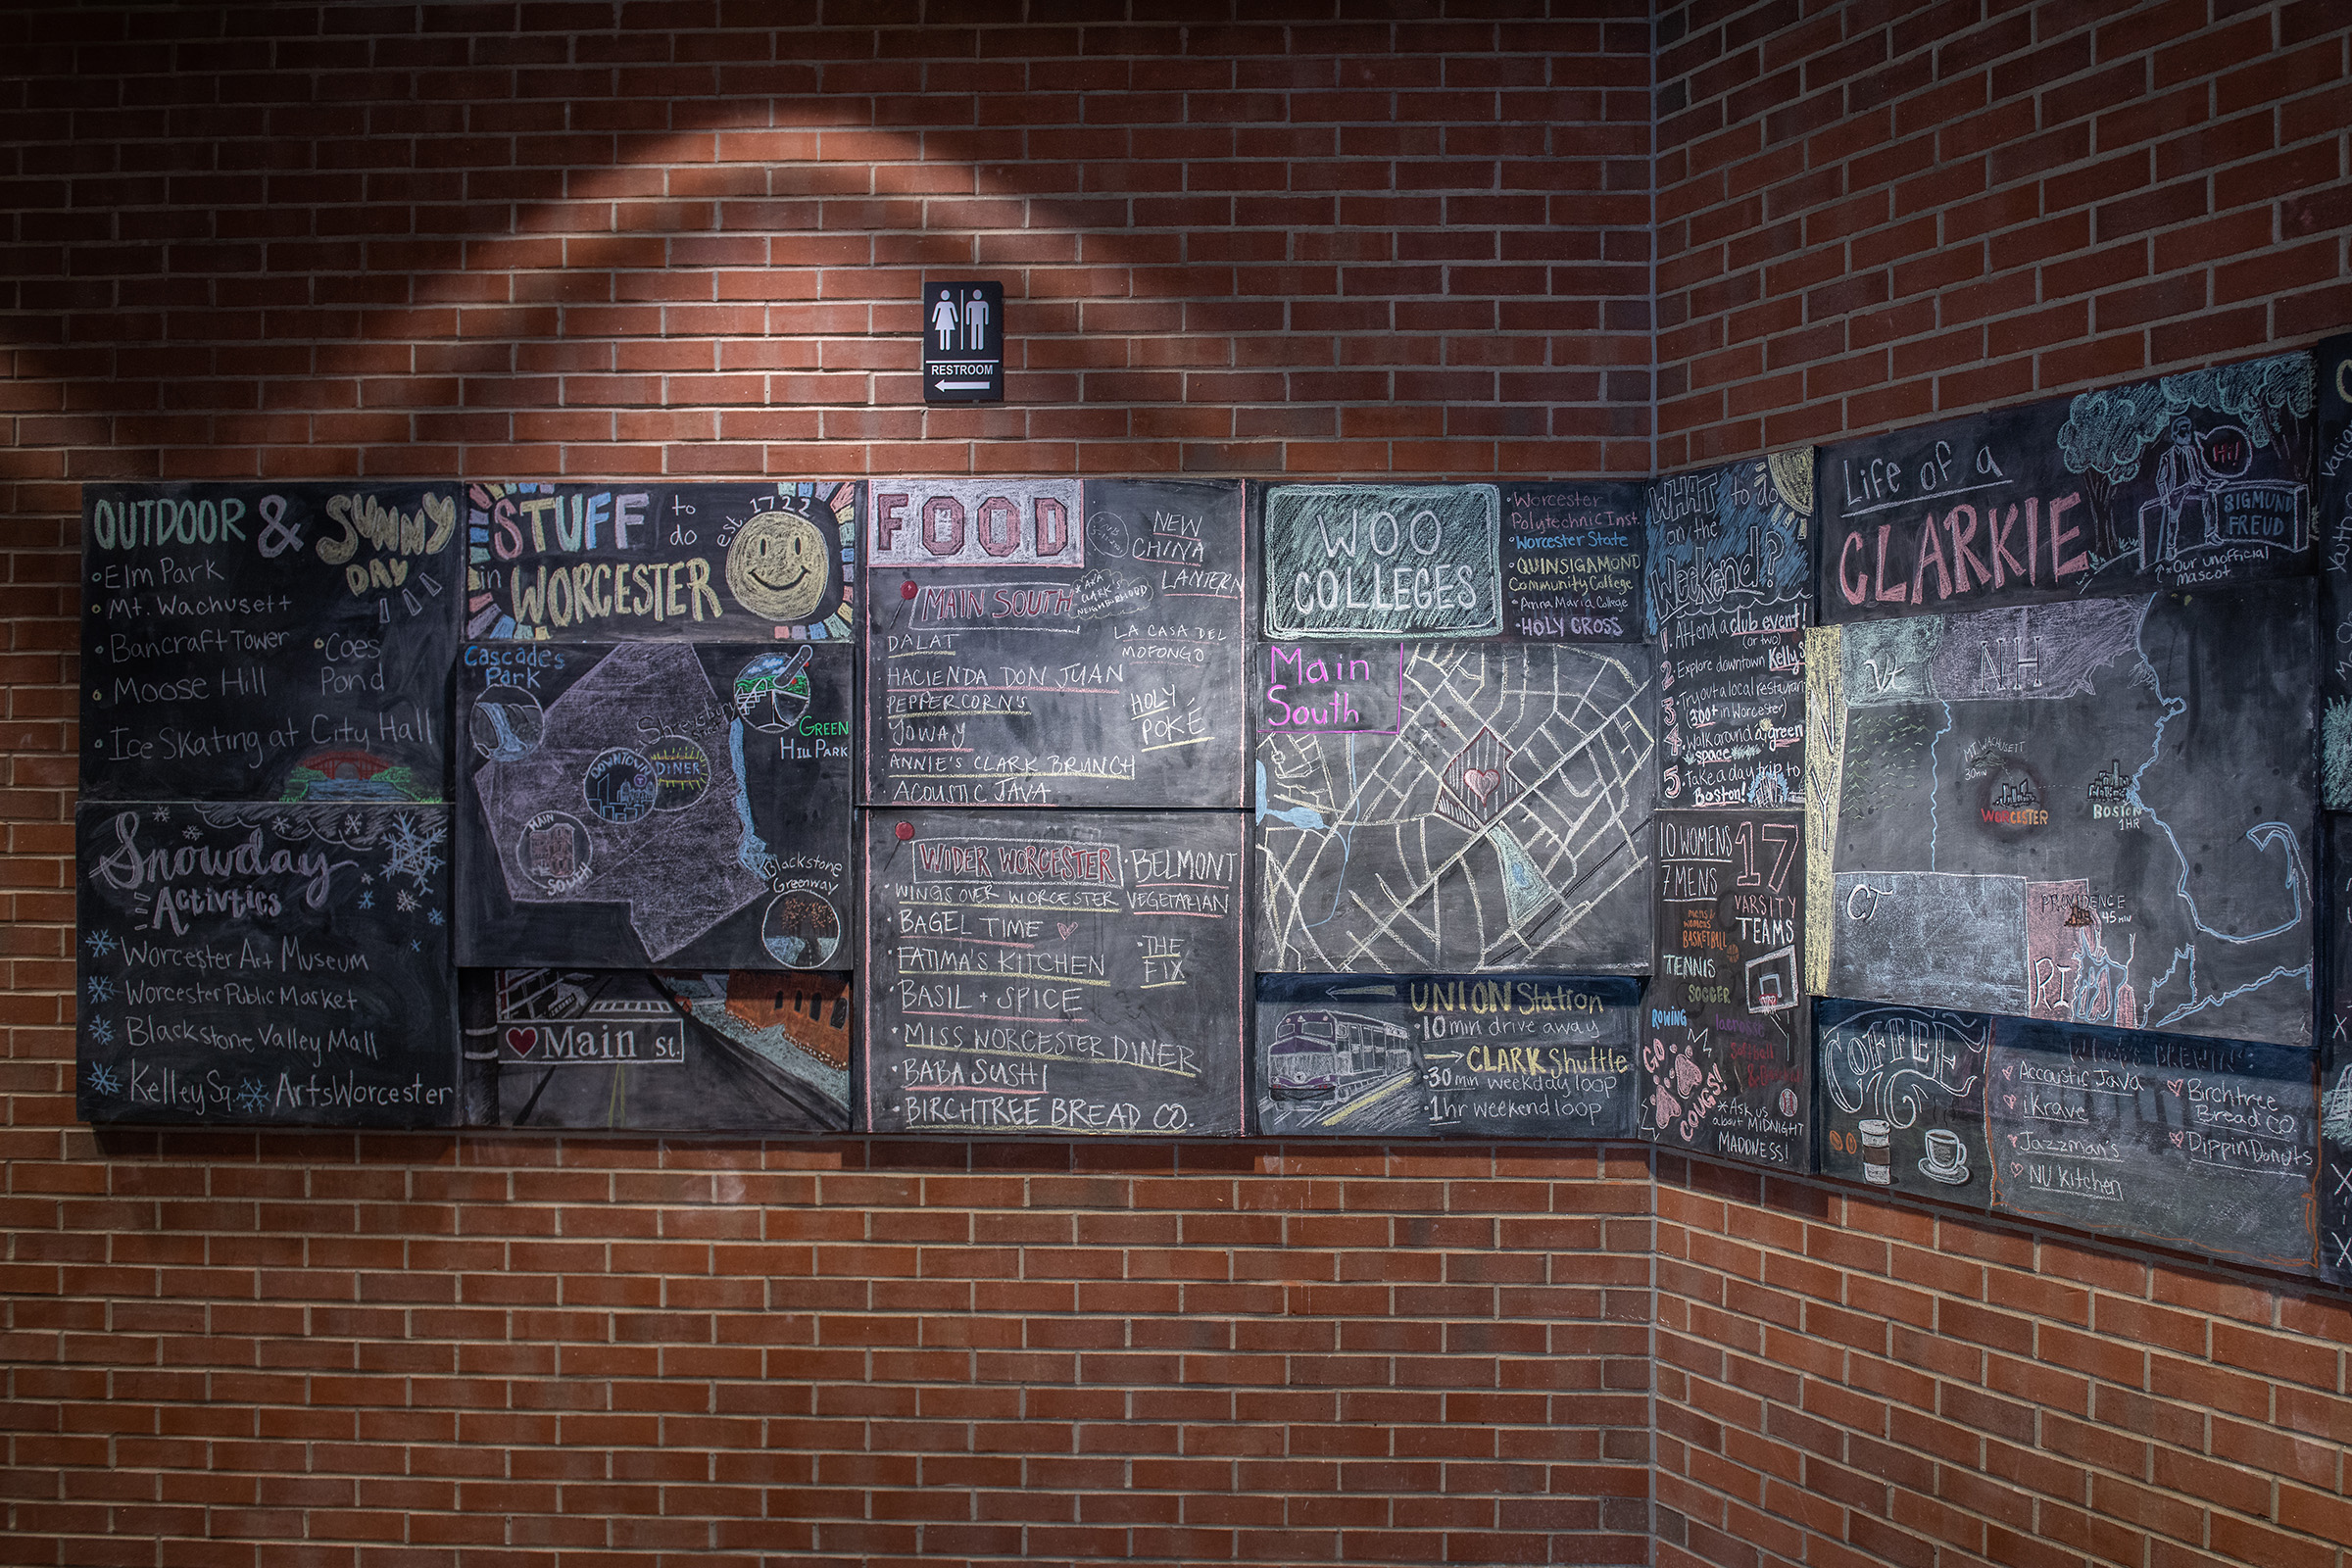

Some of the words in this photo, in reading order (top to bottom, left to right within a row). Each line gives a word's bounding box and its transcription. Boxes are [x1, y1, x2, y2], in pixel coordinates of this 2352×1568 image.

[931, 365, 993, 375] RESTROOM
[1843, 459, 1900, 507] Life
[1921, 441, 1951, 491] of
[672, 495, 696, 515] to
[750, 496, 811, 516] 1722
[1514, 492, 1602, 508] Worcester
[1648, 473, 1717, 524] WHAT
[1732, 476, 1749, 505] to
[1757, 479, 1778, 506] do
[2224, 491, 2294, 513] SIGMUND
[95, 498, 245, 550] OUTDOOR
[258, 495, 304, 557] &
[316, 492, 456, 564] SUNNY
[495, 493, 650, 561] STUFF
[670, 525, 697, 546] do
[878, 494, 1068, 558] FOOD
[1152, 511, 1202, 537] NEW
[1316, 510, 1443, 558] WOO
[1694, 517, 1717, 539] the
[2230, 514, 2284, 536] FREUD
[1132, 537, 1203, 563] CHINA
[1516, 535, 1585, 549] Worcester
[1588, 531, 1628, 548] State
[1839, 492, 2089, 605] CLARKIE
[1517, 554, 1641, 575] QUINSIGAMOND
[2203, 546, 2269, 568] unofficial
[106, 565, 153, 588] Elm
[161, 558, 223, 583] Park
[346, 559, 408, 597] DAY
[1161, 569, 1243, 597] LANTERN
[1590, 574, 1633, 595] College
[2177, 568, 2230, 586] mascot
[480, 565, 501, 588] in
[512, 558, 723, 627] WORCESTER
[1294, 564, 1477, 614] COLLEGES
[158, 595, 291, 615] Wachusett
[922, 588, 984, 621] MAIN
[992, 588, 1074, 618] SOUTH
[1520, 597, 1553, 611] Anna
[1148, 625, 1188, 638] CASA
[1522, 615, 1563, 636] HOLY
[1571, 616, 1624, 636] CROSS
[1676, 616, 1718, 649] Attend
[1730, 608, 1758, 633] club
[231, 629, 289, 651] Tower
[325, 633, 380, 662] Coes
[889, 634, 959, 652] DALAT
[466, 646, 564, 669] Cascades
[1122, 647, 1204, 662] MOFONGO
[1270, 646, 1370, 684] Main
[1677, 660, 1712, 678] Explore
[1716, 656, 1765, 674] downtown
[1769, 647, 1800, 674] Kelly
[1981, 636, 2042, 693] NH
[116, 677, 210, 704] Moose
[222, 667, 267, 696] Hill
[322, 663, 384, 695] Pond
[486, 668, 540, 688] Park
[888, 668, 989, 686] HACIENDA
[1002, 666, 1047, 686] DON
[1060, 663, 1123, 691] JUAN
[1130, 685, 1178, 715] HOLY
[1268, 685, 1359, 726] South
[109, 727, 153, 760] Ice
[270, 718, 298, 746] at
[312, 714, 368, 752] City
[380, 709, 432, 744] Hall
[799, 715, 849, 736] GREEN
[1768, 723, 1803, 752] green
[781, 738, 811, 760] HILL
[815, 738, 848, 759] PARK
[1978, 736, 2026, 753] WACHUSETT
[590, 753, 653, 779] DOWNTOWN
[656, 761, 700, 775] DINER
[974, 756, 1038, 772] CLARK
[1048, 755, 1135, 780] BRUNCH
[893, 781, 987, 803] ACOUSTIC
[993, 776, 1051, 803] JAVA
[528, 813, 555, 832] MAIN
[1981, 808, 2048, 824] WORCESTER
[2093, 804, 2141, 819] BOSTON
[100, 811, 359, 908] Snowday
[762, 855, 843, 879] Blackstone
[920, 844, 989, 876] WIDER
[998, 846, 1115, 882] WORCESTER
[1130, 848, 1238, 882] BELMONT
[1661, 822, 1675, 857] 10
[1681, 825, 1733, 858] WOMENS
[1735, 821, 1798, 893] 17
[546, 865, 593, 896] SOUTH
[772, 877, 838, 895] Greenway
[1675, 865, 1717, 897] MENS
[895, 886, 953, 904] WINGS
[959, 884, 999, 904] OVER
[1008, 891, 1119, 906] WORCESTER
[1127, 890, 1229, 913] VEGETARIAN
[1735, 895, 1795, 918] VARSITY
[899, 908, 972, 935] BAGEL
[980, 917, 1044, 939] TIME
[1736, 917, 1794, 946] TEAMS
[121, 937, 231, 969] Worcester
[240, 939, 272, 968] Art
[282, 936, 368, 971] Museum
[1142, 935, 1183, 956] THE
[1683, 931, 1727, 950] BASKETBALL
[998, 951, 1105, 976] KITCHEN
[1144, 959, 1186, 983] FIX
[1664, 955, 1716, 978] TENNIS
[126, 980, 221, 1005] Worcester
[224, 983, 272, 1004] Public
[280, 986, 357, 1010] Market
[898, 979, 972, 1011] BASIL
[998, 987, 1082, 1012] SPICE
[2034, 957, 2072, 1010] RI
[1411, 981, 1511, 1014] UNION
[1519, 984, 1603, 1014] Station
[1489, 1016, 1535, 1034] drive
[1543, 1022, 1599, 1038] away
[125, 1016, 254, 1053] Blackstone
[259, 1024, 320, 1066] Valley
[328, 1031, 377, 1059] Mall
[541, 1025, 637, 1058] Main
[905, 1023, 963, 1048] MISS
[974, 1029, 1104, 1057] WORCESTER
[1113, 1036, 1201, 1073] DINER
[902, 1059, 964, 1089] BABA
[971, 1060, 1048, 1092] SUSHI
[1467, 1046, 1546, 1074] CLARK
[1548, 1047, 1628, 1078] Shuttle
[1824, 1017, 1978, 1115] COFFEE
[131, 1059, 204, 1115] Kelley
[1488, 1075, 1571, 1097] weekday
[1576, 1074, 1617, 1098] loop
[2094, 1068, 2143, 1091] Java
[2188, 1079, 2278, 1111] Birchtree
[906, 1097, 1041, 1127] BIRCHTREE
[1051, 1098, 1141, 1127] BREAD
[1444, 1097, 1468, 1117] hr
[1474, 1095, 1550, 1118] weekend
[1555, 1101, 1602, 1125] loop
[2196, 1104, 2260, 1127] Bread
[1748, 1117, 1803, 1136] MIDNIGHT
[2030, 1164, 2052, 1185] NU
